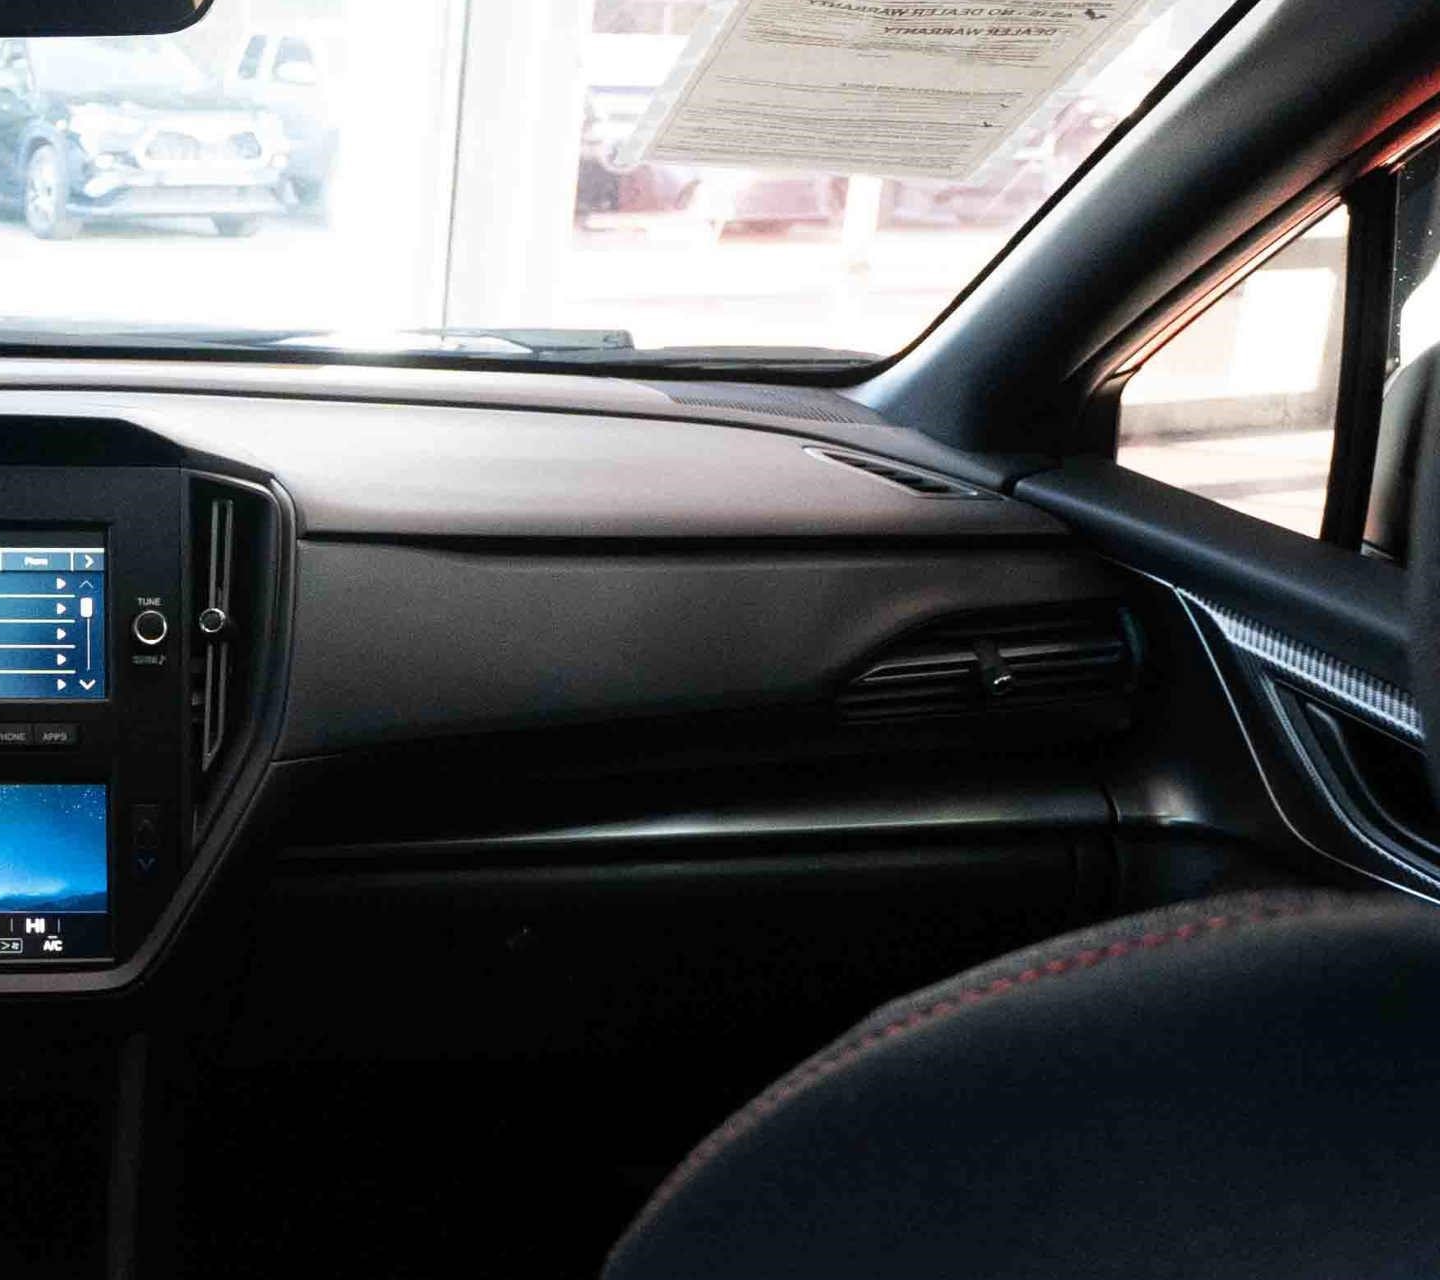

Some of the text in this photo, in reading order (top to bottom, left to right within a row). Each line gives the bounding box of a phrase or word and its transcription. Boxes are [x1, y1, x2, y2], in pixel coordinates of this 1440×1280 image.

[137, 597, 161, 606] TUNE
[25, 918, 46, 934] HI
[42, 940, 63, 952] A/C
